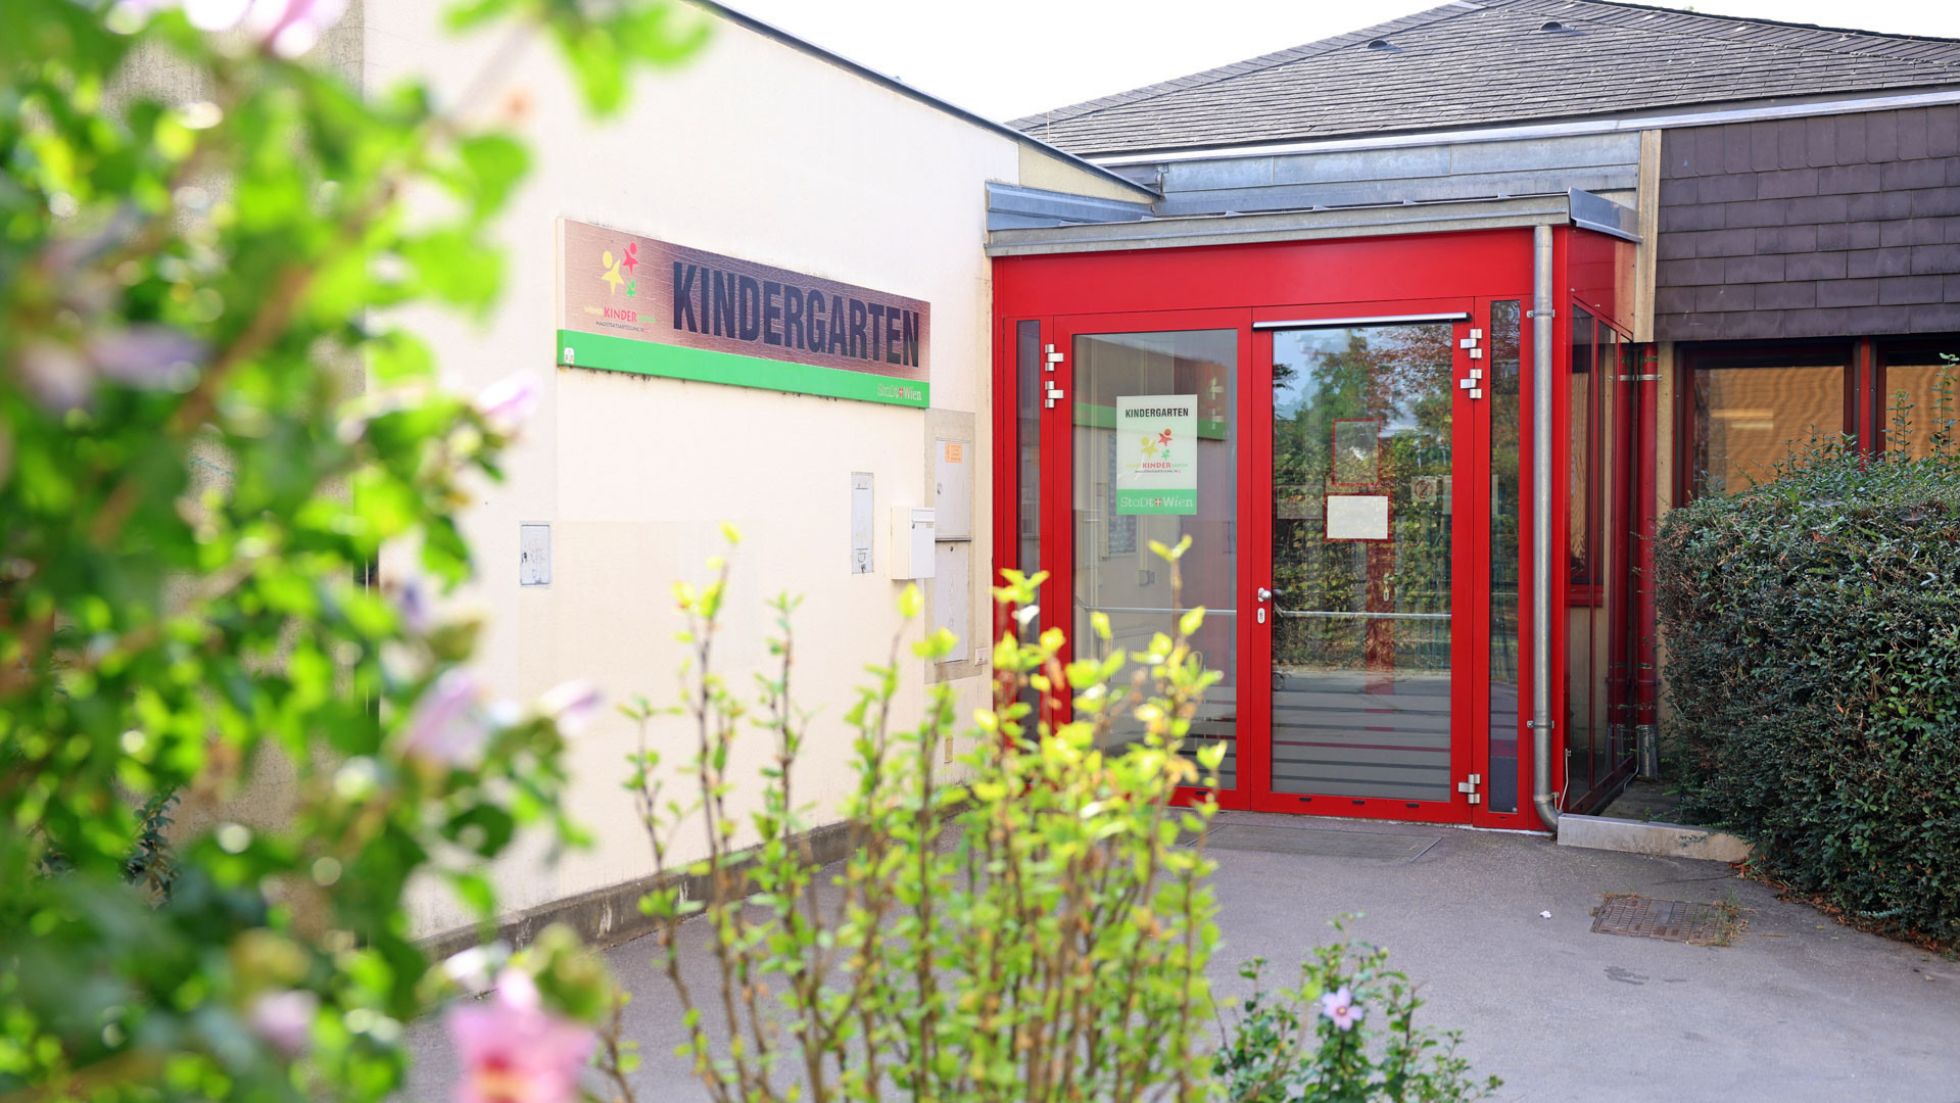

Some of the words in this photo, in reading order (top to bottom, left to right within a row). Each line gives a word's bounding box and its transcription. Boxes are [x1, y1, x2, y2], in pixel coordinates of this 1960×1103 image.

[603, 306, 638, 322] KINDER
[673, 261, 919, 369] KINDERGARTEN
[903, 385, 922, 401] Wien
[1125, 407, 1189, 418] KINDERGARTEN
[1163, 496, 1193, 508] Wien
